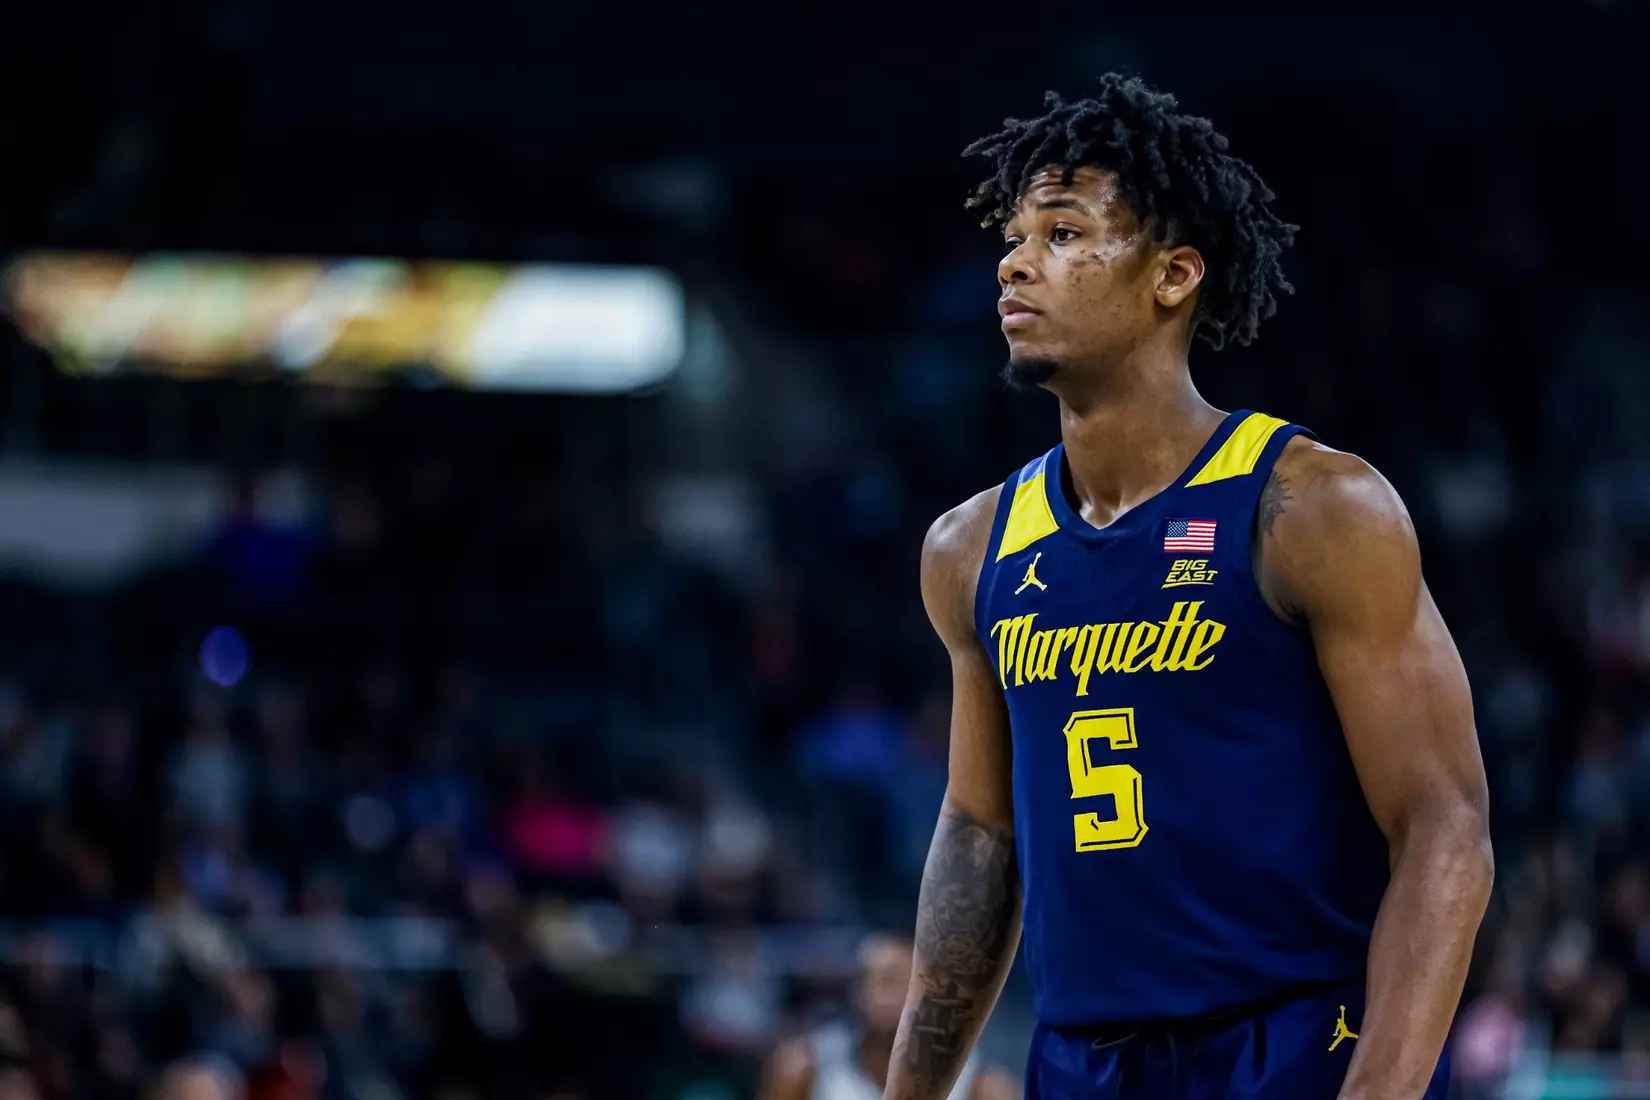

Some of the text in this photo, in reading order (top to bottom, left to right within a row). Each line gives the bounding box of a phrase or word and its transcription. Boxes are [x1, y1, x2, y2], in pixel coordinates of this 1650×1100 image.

[1165, 570, 1218, 582] EAST
[1171, 559, 1209, 571] BIG
[990, 601, 1227, 696] Marquette
[1063, 707, 1149, 852] 5
